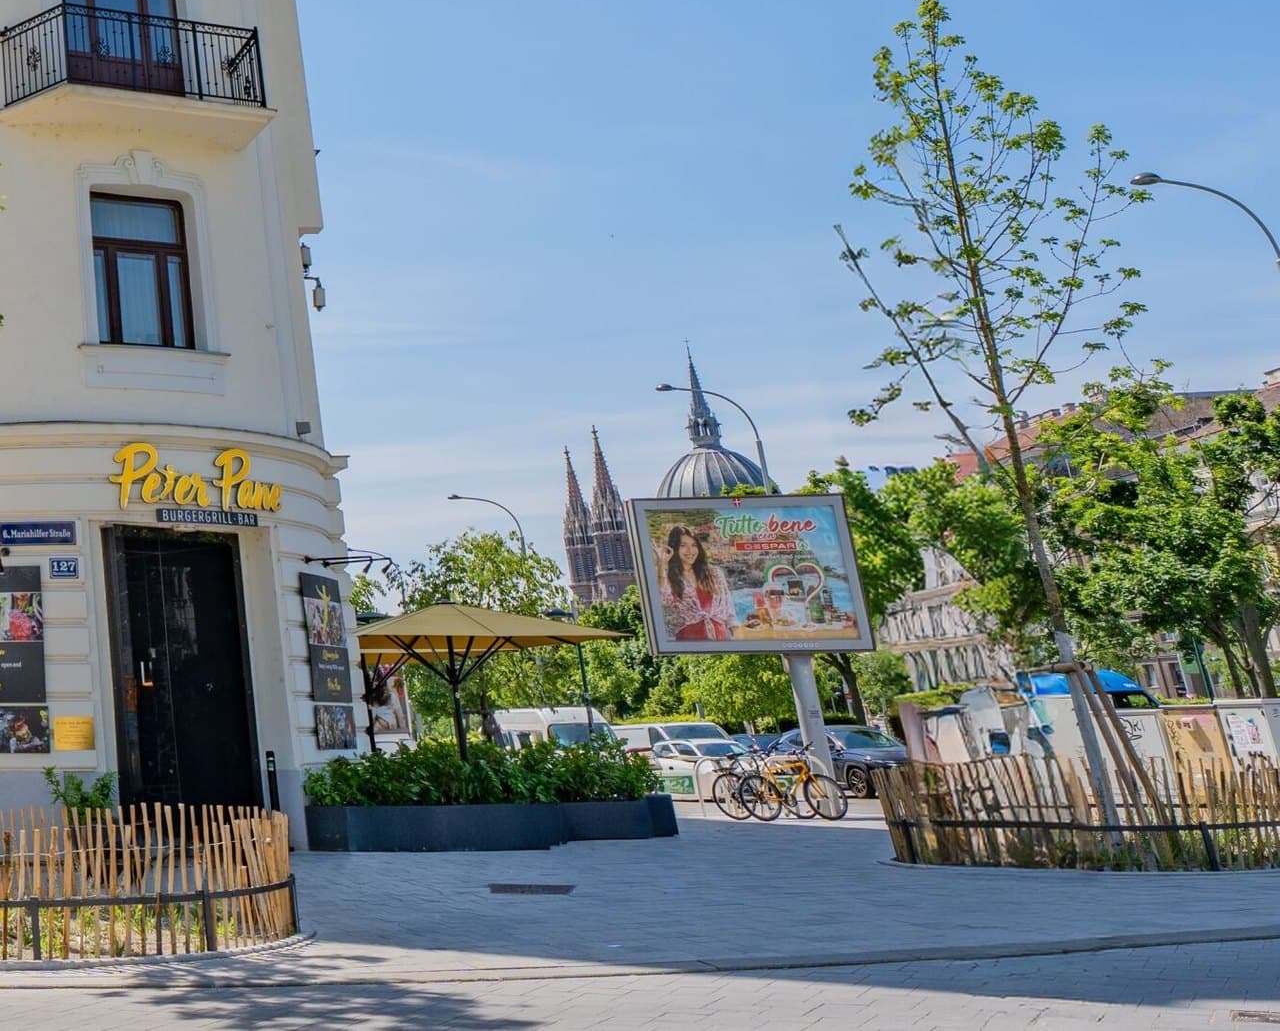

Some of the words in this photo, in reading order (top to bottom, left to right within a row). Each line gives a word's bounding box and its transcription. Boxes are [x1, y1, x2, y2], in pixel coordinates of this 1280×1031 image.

[109, 442, 211, 510] Peter
[212, 448, 282, 513] Pane
[11, 528, 49, 538] Mariahilfer
[49, 528, 71, 538] Straße
[714, 512, 766, 540] Tutto
[767, 512, 817, 533] bene
[53, 561, 76, 571] 127
